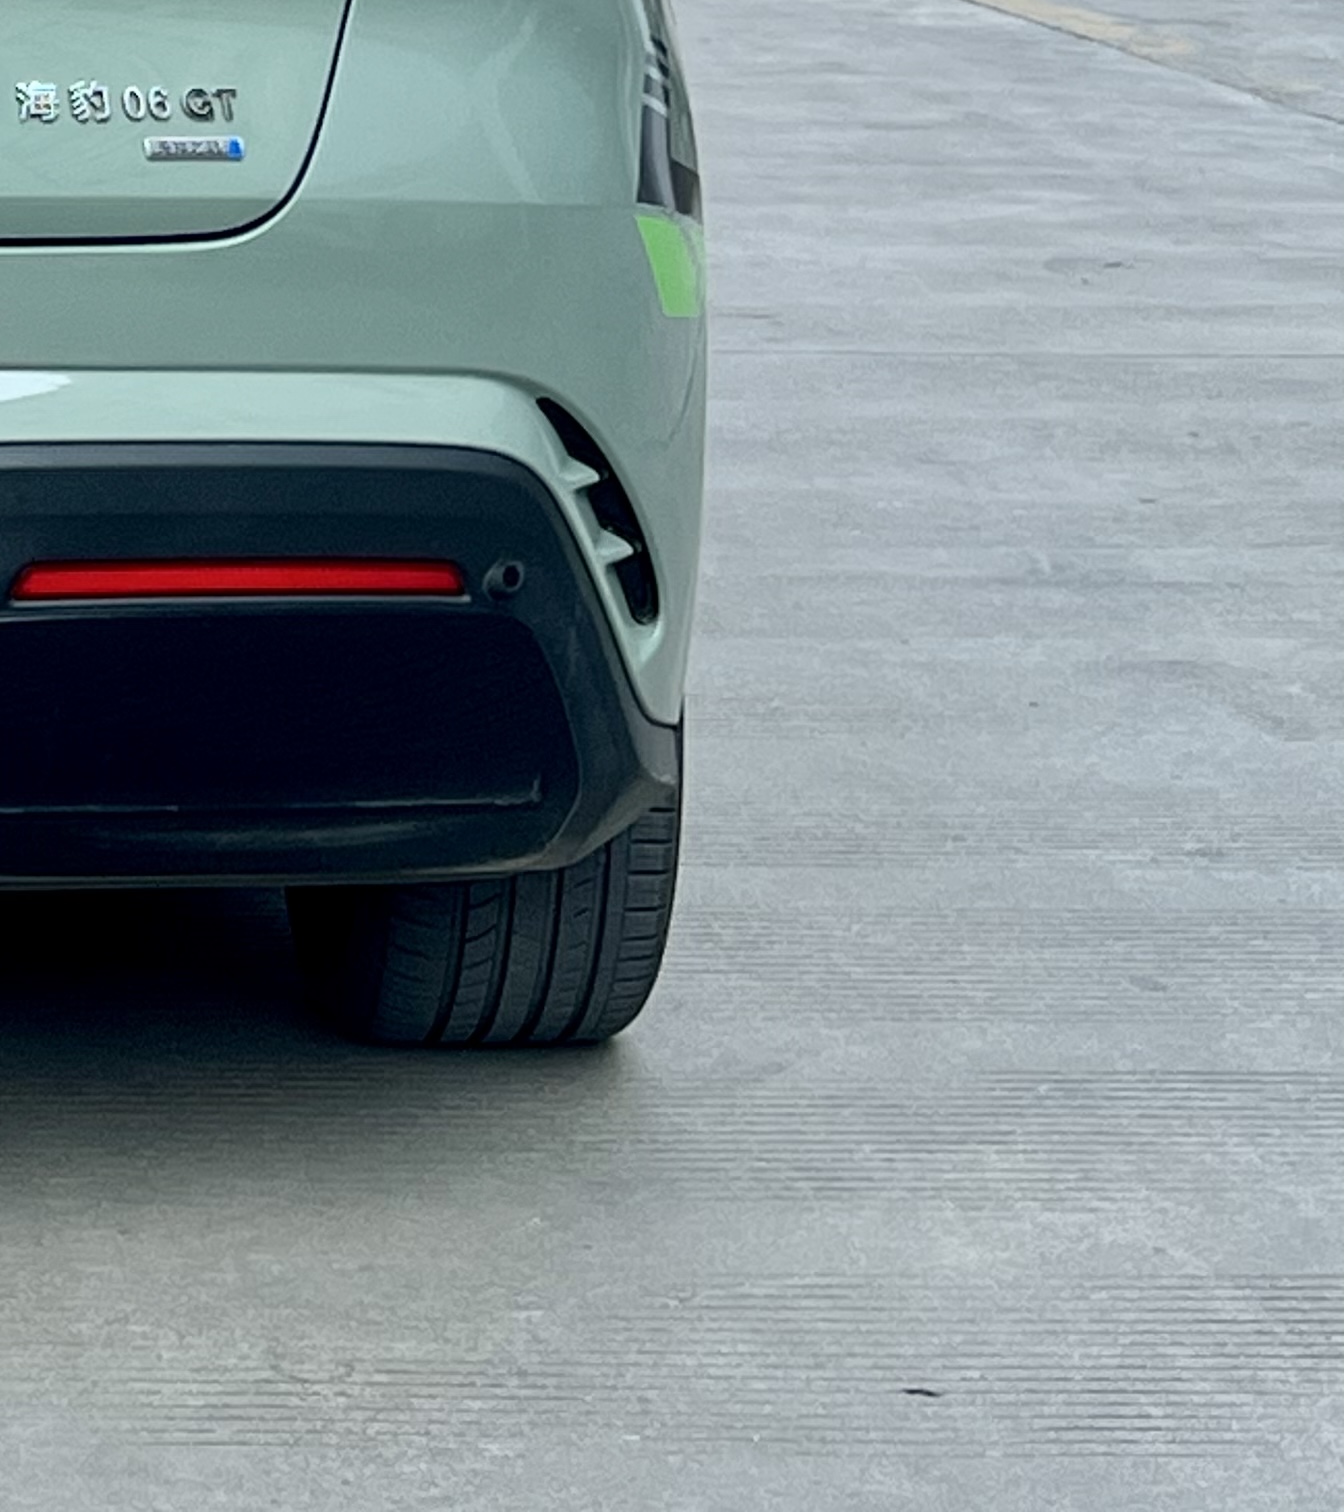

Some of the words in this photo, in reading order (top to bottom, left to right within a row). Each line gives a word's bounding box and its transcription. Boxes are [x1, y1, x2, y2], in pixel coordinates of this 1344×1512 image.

[14, 80, 113, 123] 海豹
[121, 86, 173, 122] 06
[180, 87, 238, 122] GT
